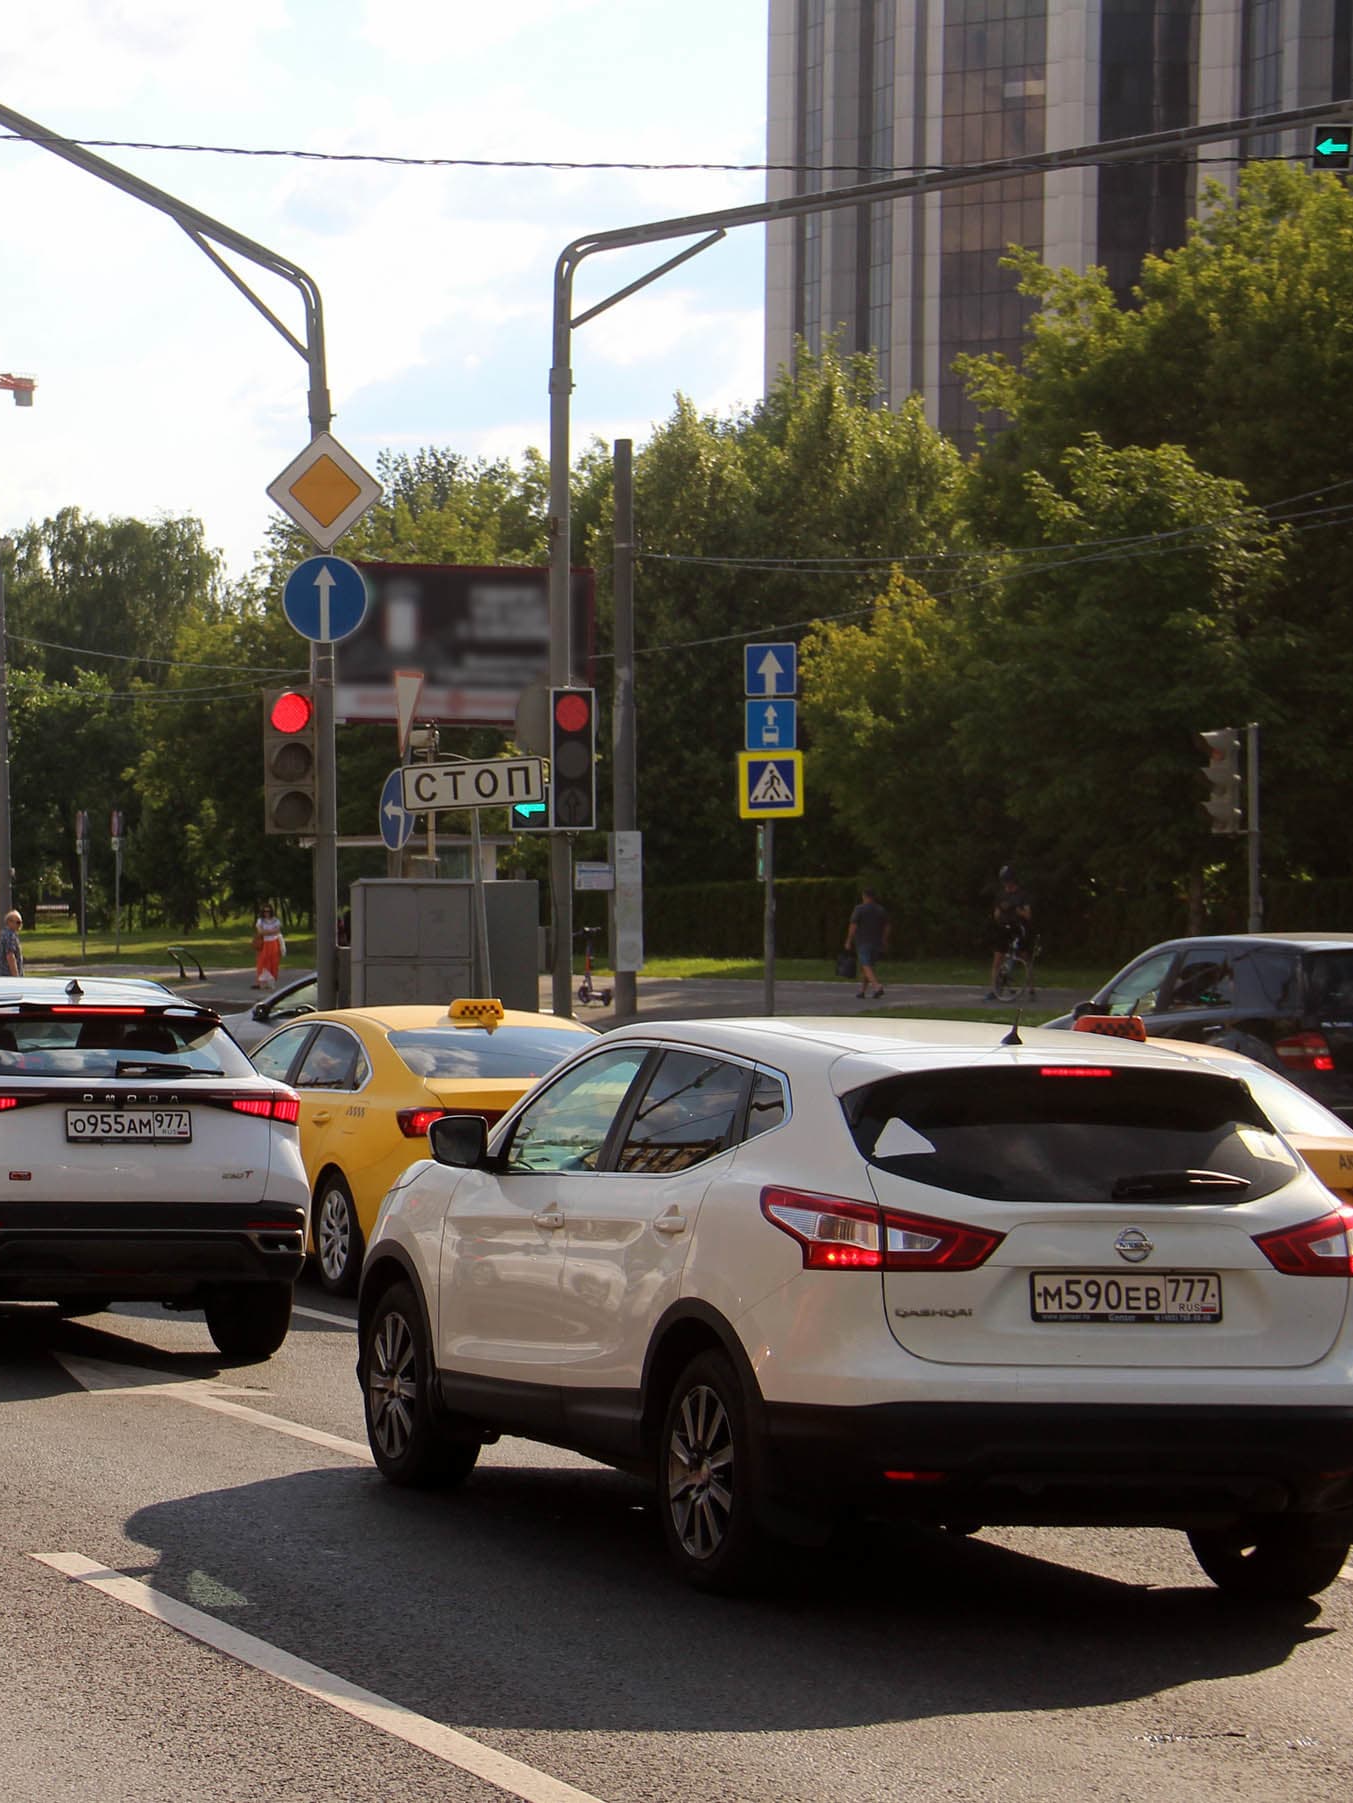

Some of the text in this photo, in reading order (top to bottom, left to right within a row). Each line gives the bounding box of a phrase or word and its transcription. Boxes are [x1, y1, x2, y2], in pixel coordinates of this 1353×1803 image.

[414, 766, 531, 802] СТОП
[155, 1113, 184, 1129] 977
[1167, 1279, 1210, 1302] 777
[1178, 1303, 1201, 1312] RUS
